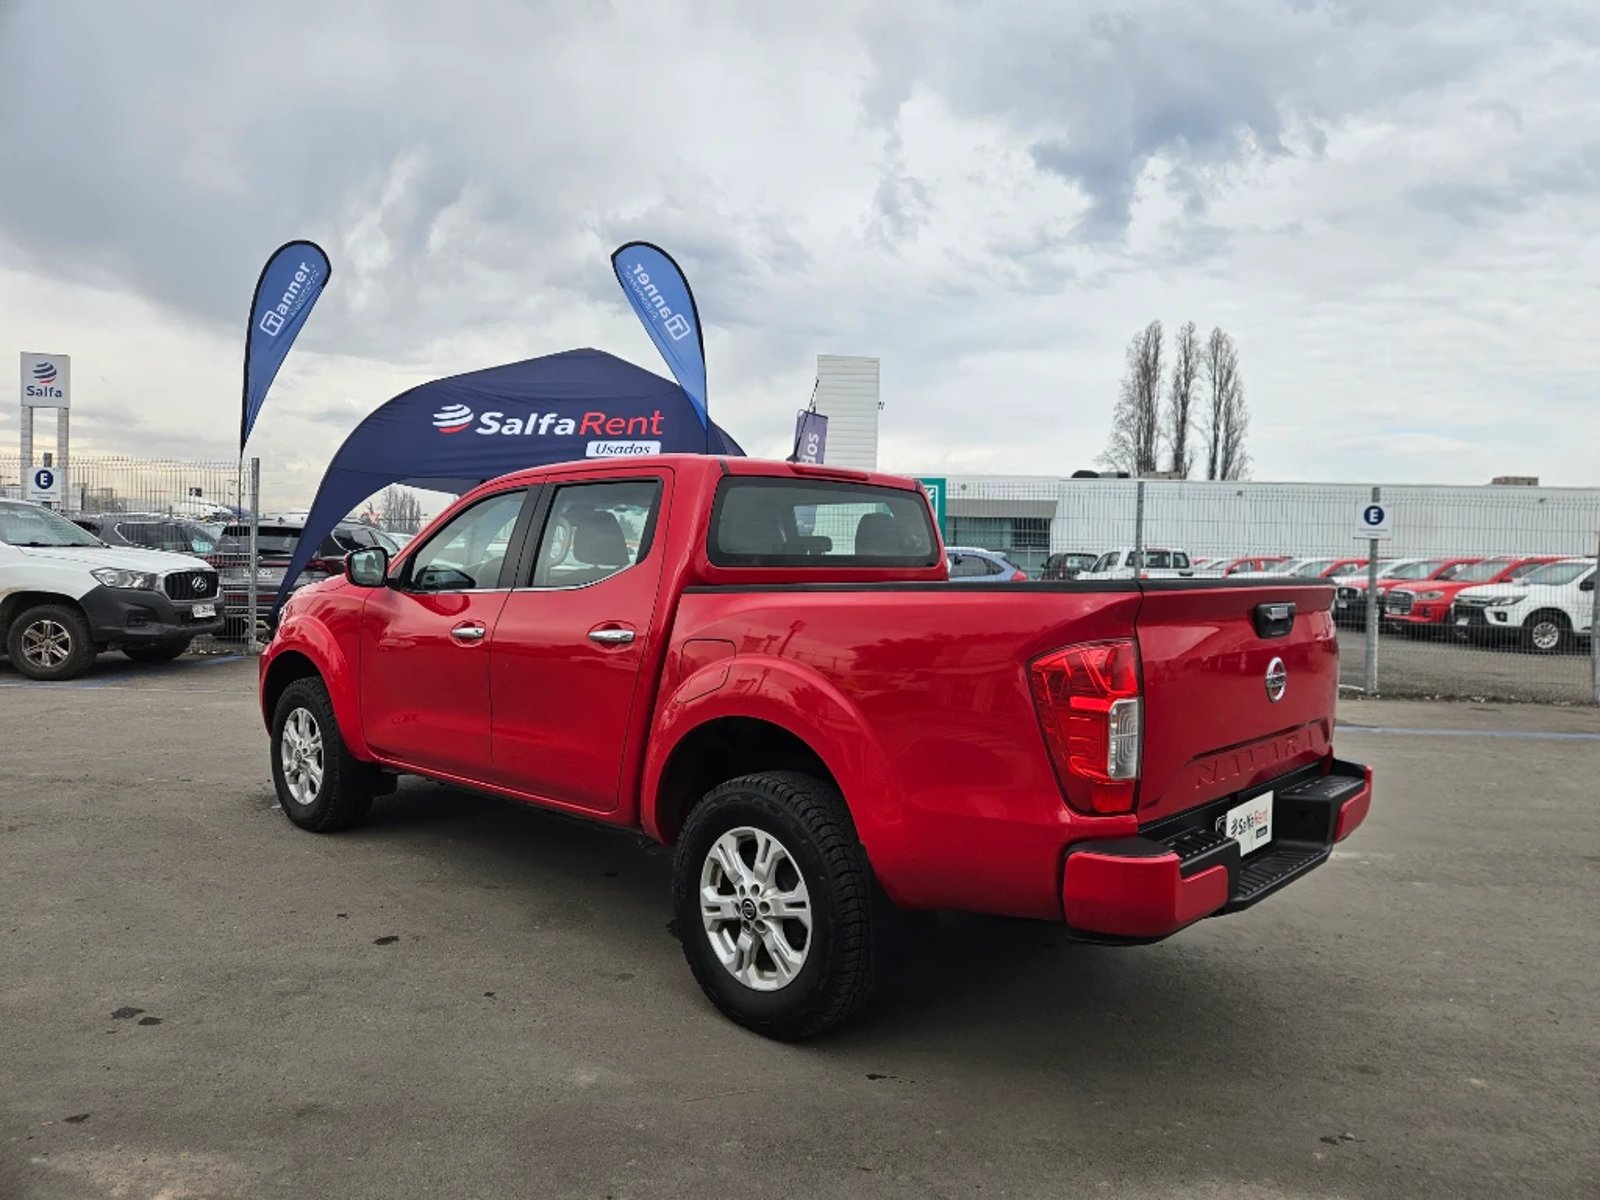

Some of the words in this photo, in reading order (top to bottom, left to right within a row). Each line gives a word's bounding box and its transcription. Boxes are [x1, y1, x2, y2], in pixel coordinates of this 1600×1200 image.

[260, 262, 310, 337] Tanner
[26, 385, 63, 398] Salfa
[595, 442, 651, 456] Usados
[39, 473, 48, 486] E
[1369, 508, 1379, 522] E
